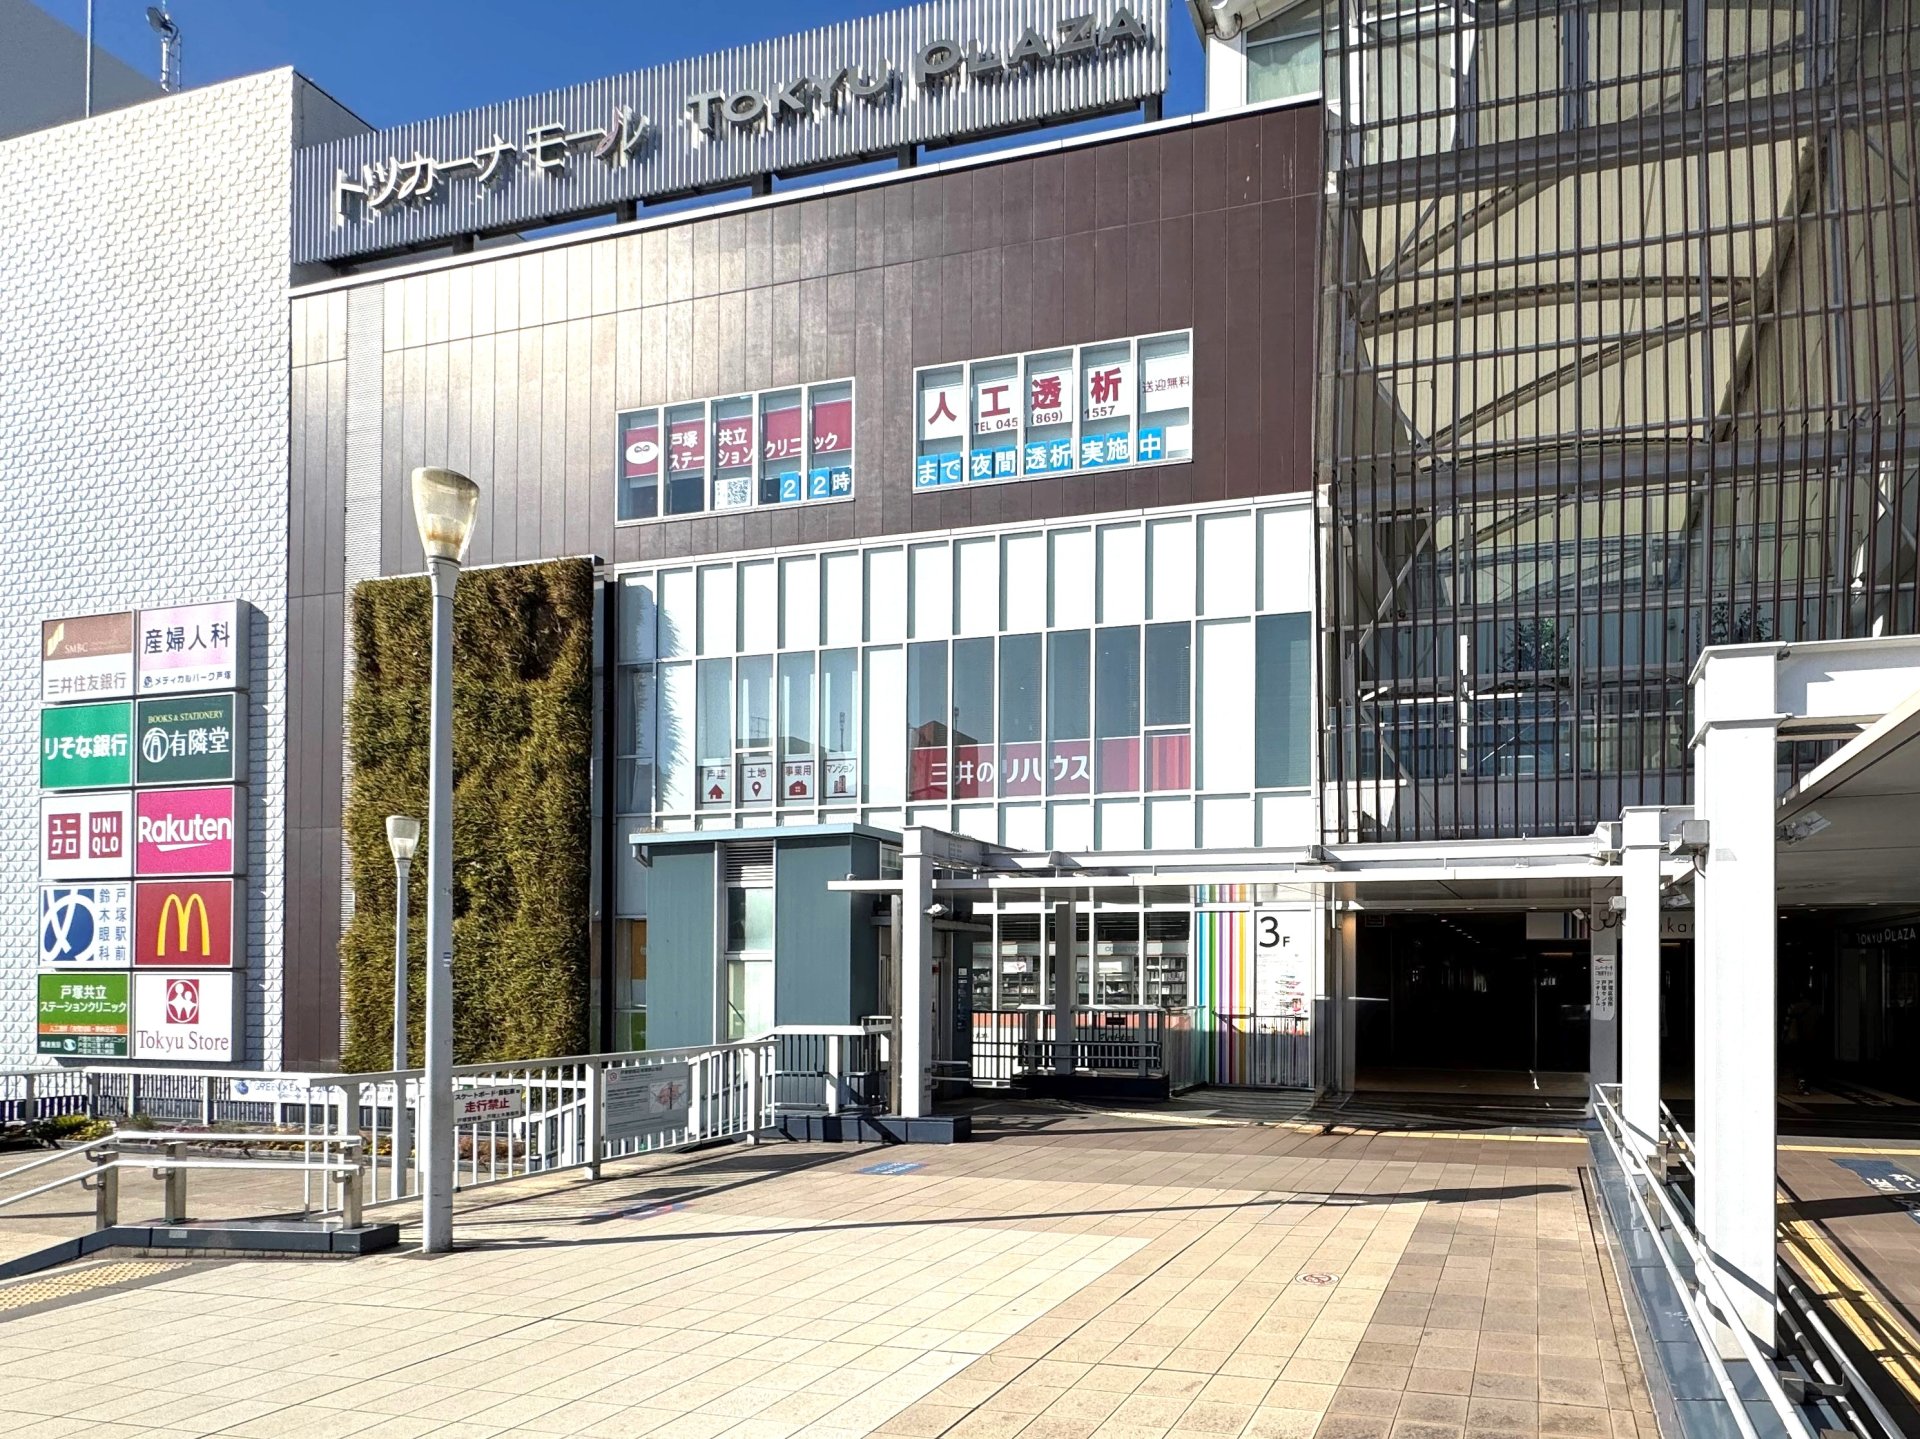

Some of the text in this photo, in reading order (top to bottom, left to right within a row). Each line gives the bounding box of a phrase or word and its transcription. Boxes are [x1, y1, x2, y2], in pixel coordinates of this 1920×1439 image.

[687, 6, 1148, 134] TOKYU PLAZA
[335, 105, 650, 220] トツカーナモール
[1143, 376, 1190, 393] 送迎無料
[928, 367, 1122, 425] 人工透析
[974, 421, 992, 432] TEL
[996, 417, 1018, 430] 045
[144, 621, 230, 654] 産婦人科
[65, 642, 88, 654] SMBC
[48, 672, 127, 694] 三井住友銀行
[155, 671, 231, 685] メディカルパーク戸塚
[148, 714, 173, 724] BOOKS
[180, 710, 224, 721] STATIONERY
[45, 733, 128, 760] りそな銀行
[169, 726, 230, 757] 有隣堂
[747, 767, 767, 778] 土地
[785, 764, 812, 777] 事業用
[826, 763, 854, 774] マンション
[52, 818, 77, 836] ユニ
[92, 817, 117, 833] UNI
[139, 813, 232, 844] Rakuten
[51, 838, 77, 855] クロ
[92, 837, 119, 856] QLO
[99, 888, 110, 961] 鈴木眼科
[115, 887, 127, 961] 戸塚駅前
[1856, 927, 1916, 945] TOKYU PLAZA
[60, 985, 107, 1000] 戸塚共立
[40, 1001, 127, 1013] ステーションクリニック
[137, 1030, 229, 1053] Tokyu Store
[464, 1097, 510, 1113] 走行禁止
